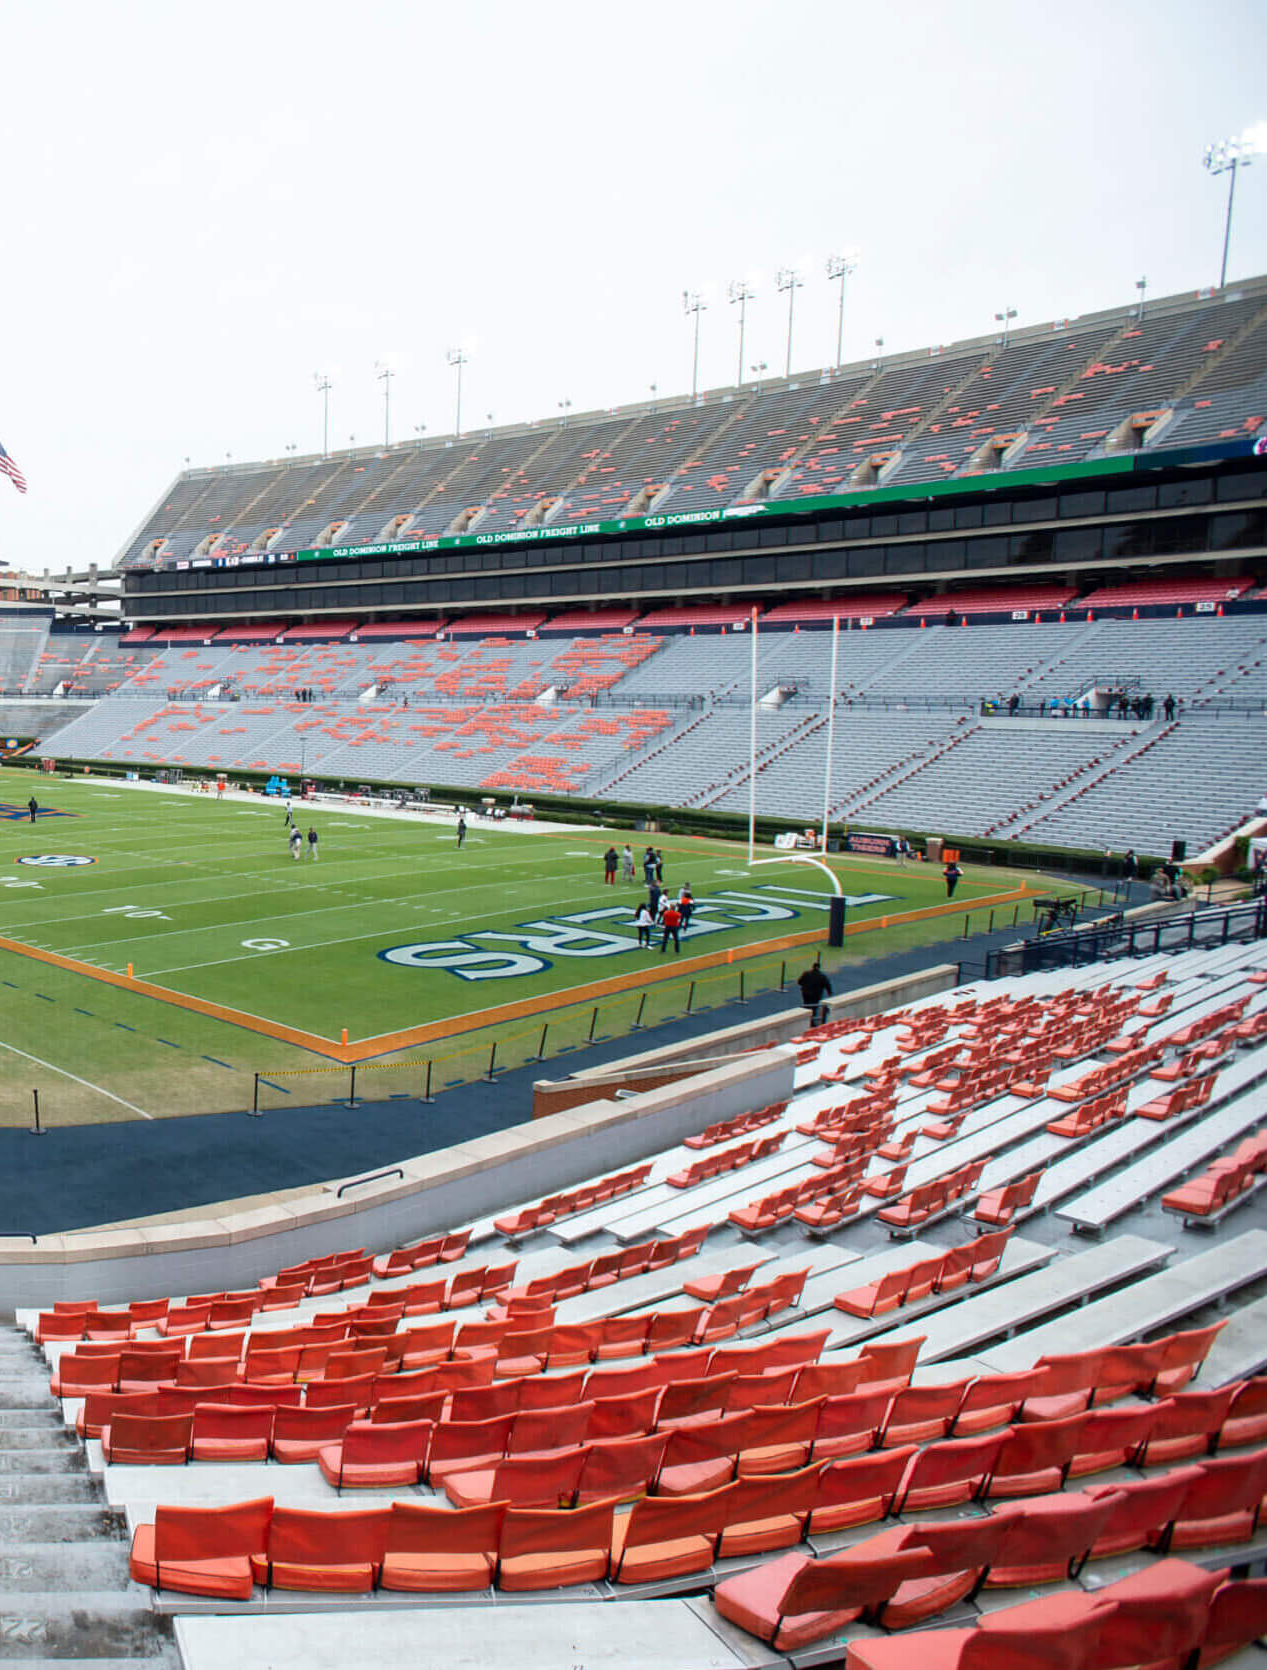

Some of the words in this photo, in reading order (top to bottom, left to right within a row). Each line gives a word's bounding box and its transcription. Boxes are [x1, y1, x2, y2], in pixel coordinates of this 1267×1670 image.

[644, 517, 665, 527] OLD
[667, 511, 720, 525] DOMINION
[476, 536, 493, 545] OLD
[494, 531, 539, 543] DOMINION
[540, 527, 578, 538] FREIGHT
[580, 524, 600, 534] LINE
[332, 549, 346, 557] OLD
[349, 545, 386, 556] DOMINION
[421, 540, 439, 550] LINE
[240, 938, 290, 951] G
